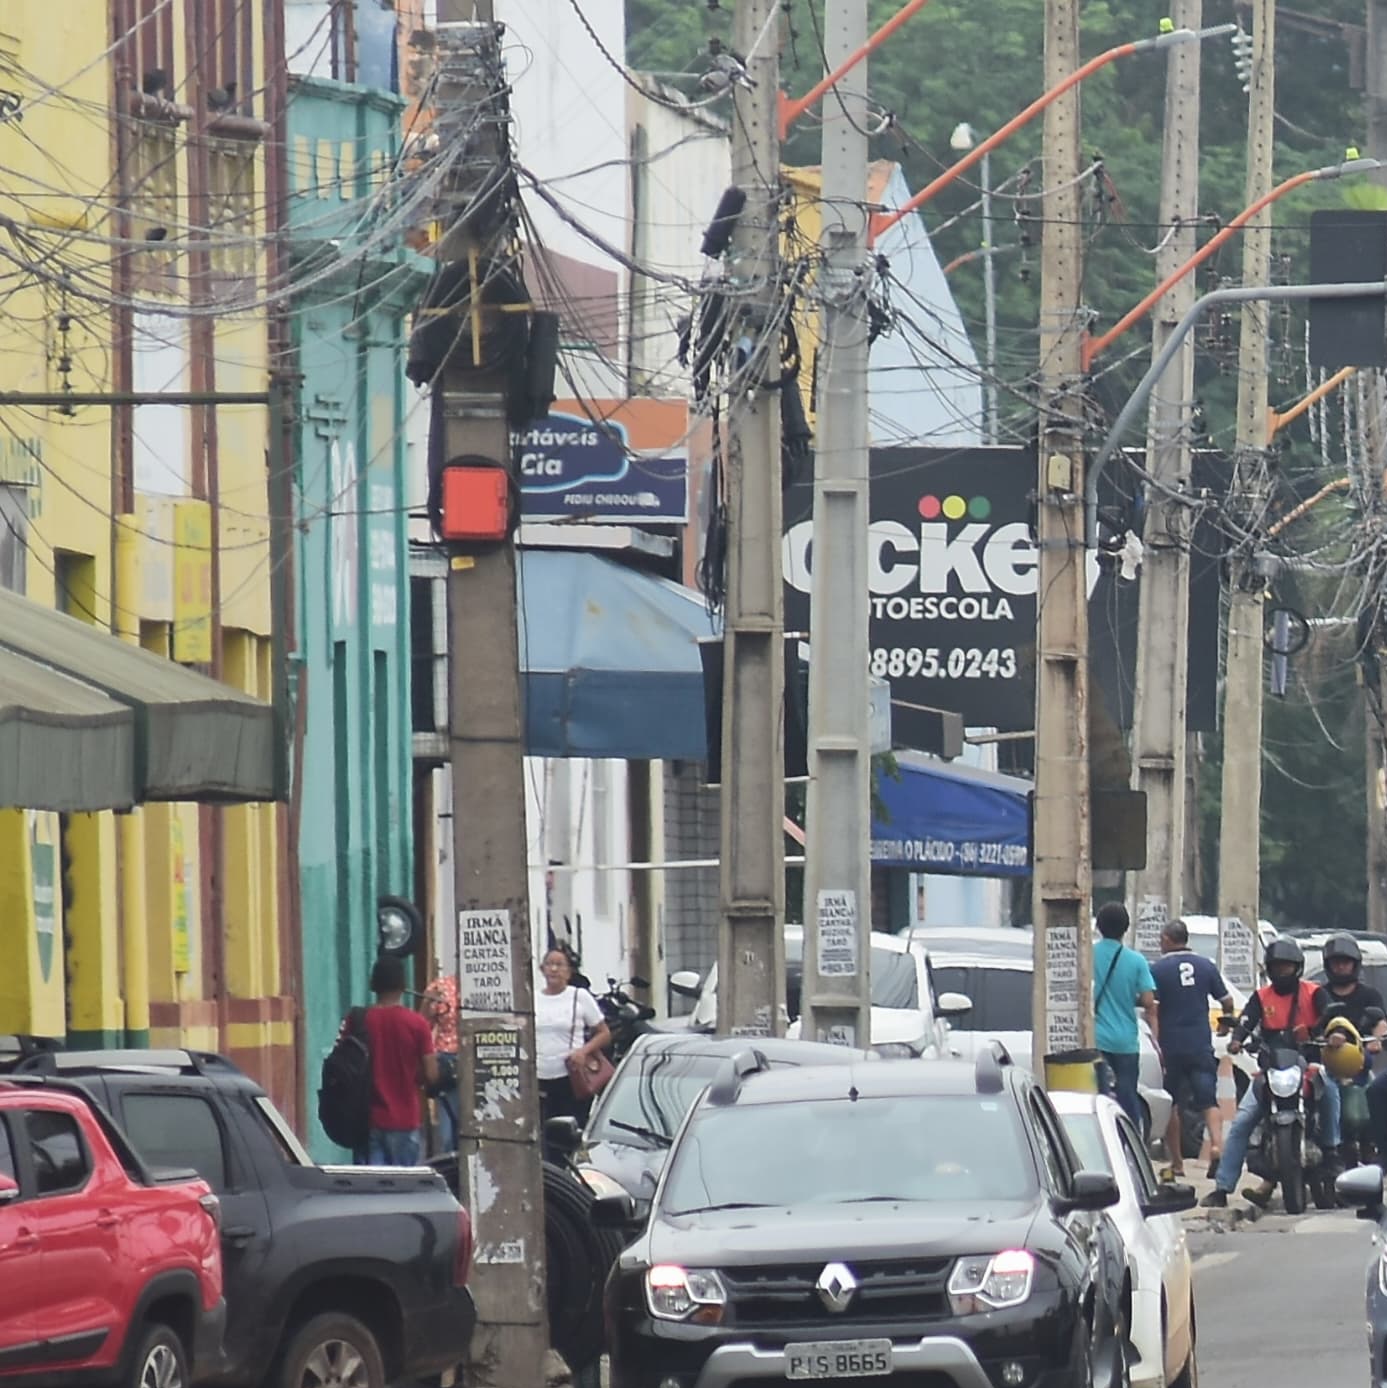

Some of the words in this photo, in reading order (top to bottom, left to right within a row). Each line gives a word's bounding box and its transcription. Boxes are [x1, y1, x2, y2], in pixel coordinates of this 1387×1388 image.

[520, 453, 563, 476] Cia
[463, 929, 509, 946] BIANCA
[1179, 961, 1196, 987] 2
[836, 1352, 887, 1373] 8665
